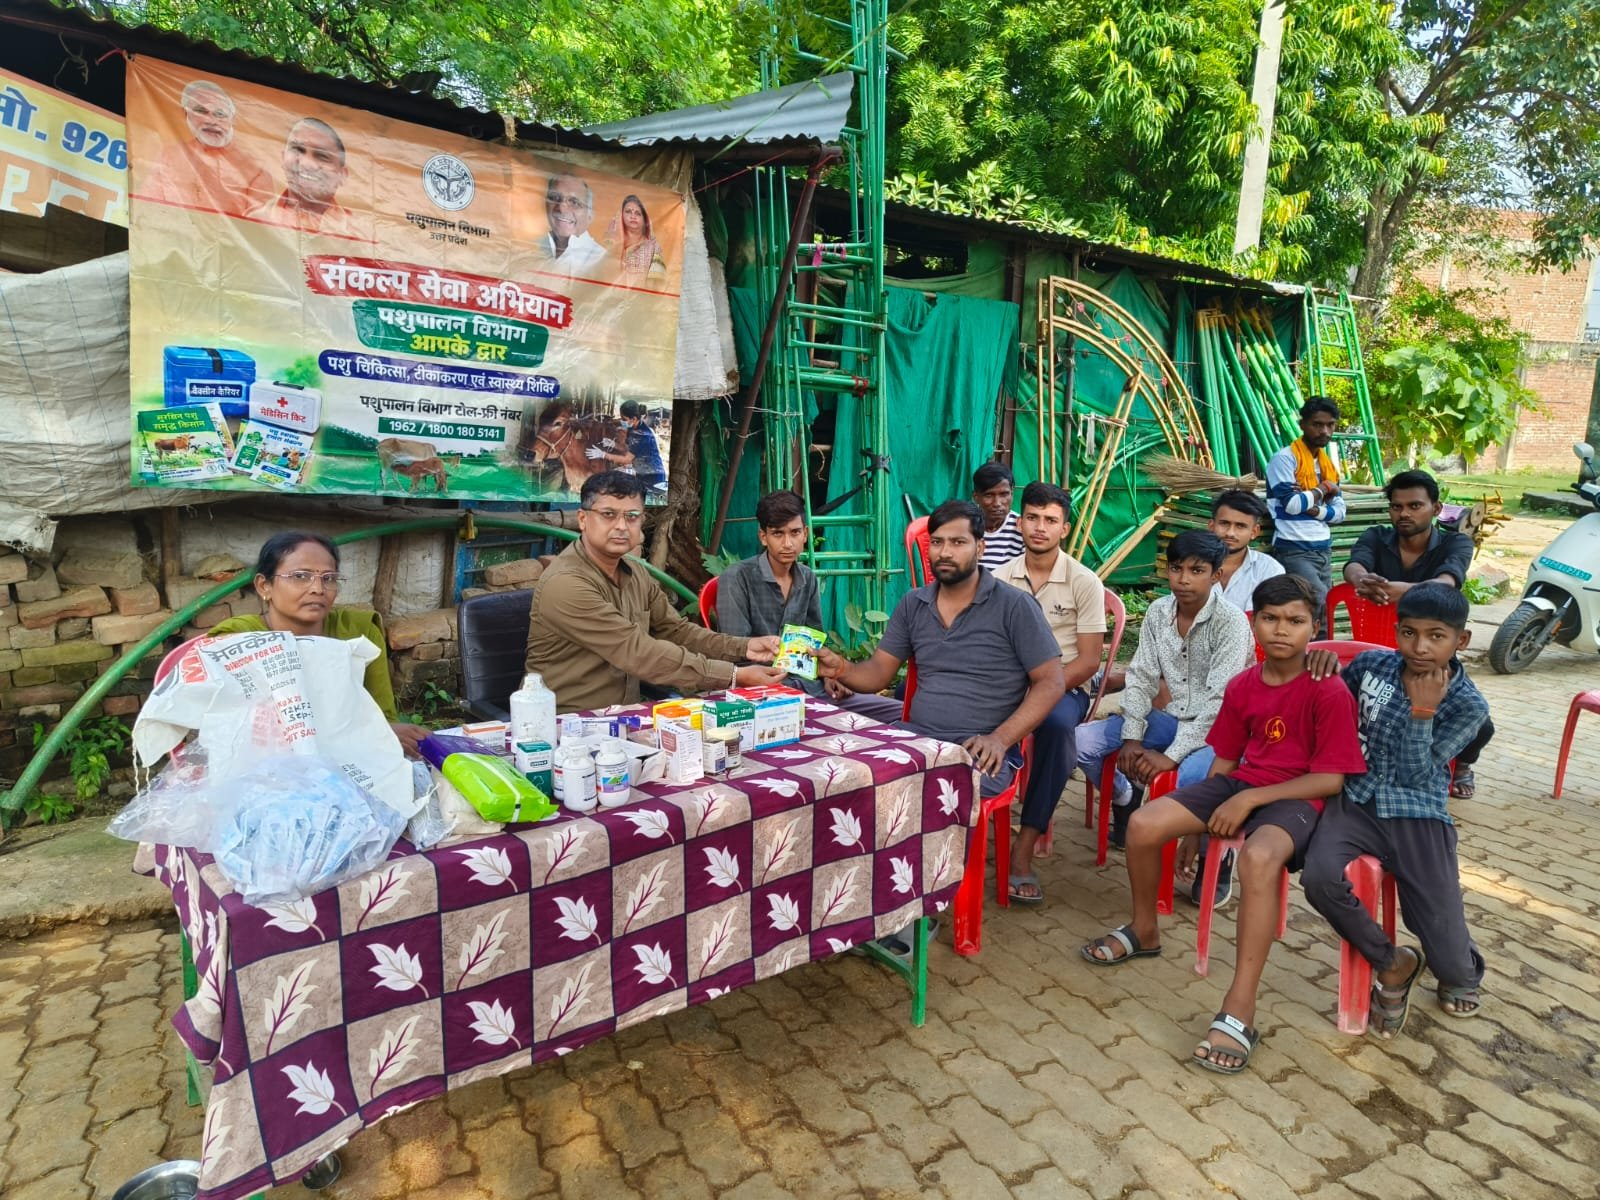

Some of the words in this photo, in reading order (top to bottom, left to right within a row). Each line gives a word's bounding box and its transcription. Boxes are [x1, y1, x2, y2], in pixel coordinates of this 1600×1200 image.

[62, 121, 128, 170] 926
[405, 212, 456, 230] पशुपालन
[458, 220, 490, 238] विभाग
[430, 231, 446, 242] उत्तर
[448, 233, 468, 246] प्रदेश
[320, 258, 411, 295] संकल्प
[417, 270, 470, 303] सेवा
[476, 281, 566, 324] अभियान
[377, 307, 468, 333] पशुपालन
[472, 315, 528, 343] विभाग
[409, 333, 471, 355] आपके
[476, 341, 508, 361] द्वार
[327, 356, 352, 376] पशु
[355, 356, 410, 381] चिकित्सा,
[414, 364, 468, 385] टीकाकरण
[470, 372, 486, 387] एवं
[488, 376, 524, 391] स्वास्थ्य
[526, 376, 555, 394] शिविर
[291, 411, 307, 423] किट
[360, 395, 415, 413] पशुपालन
[418, 398, 452, 415] विभाग
[454, 402, 498, 420] टोल-फ्री
[500, 407, 523, 421] नंबर
[389, 420, 416, 432] 1962
[428, 424, 454, 435] 1800
[456, 426, 475, 437] 180
[477, 428, 500, 438] 5141
[254, 648, 270, 660] FOR
[270, 644, 284, 654] USE
